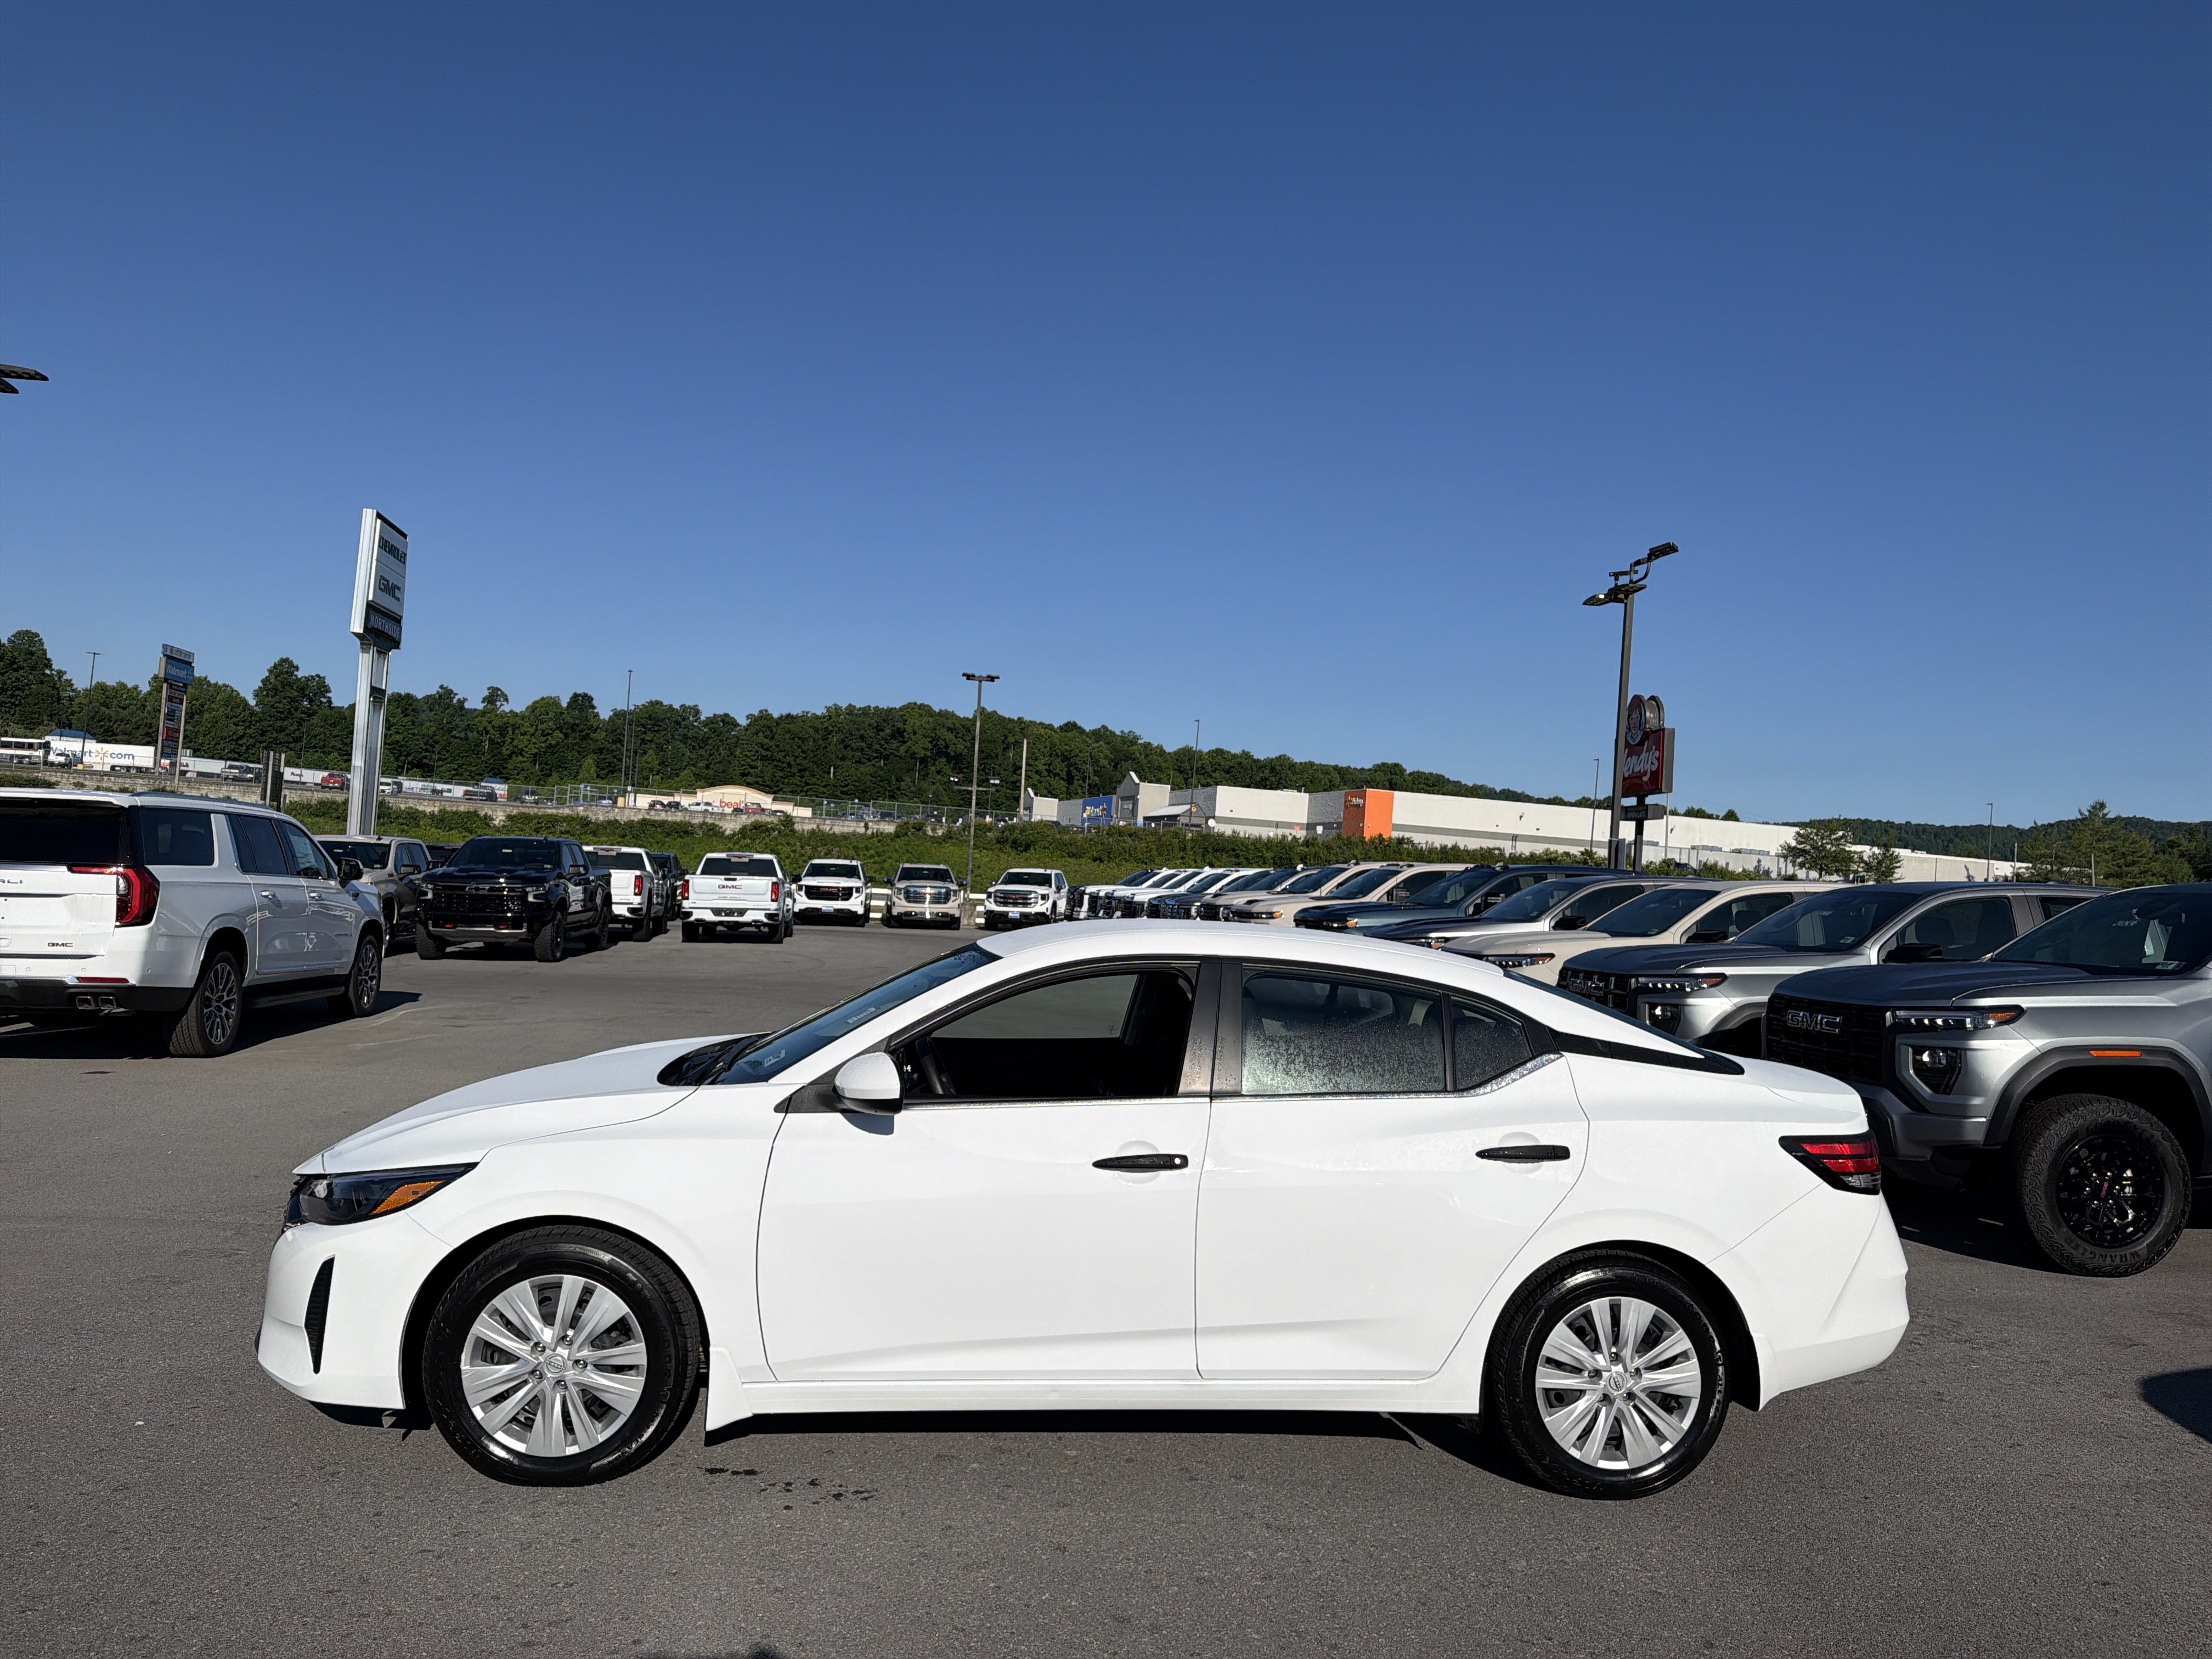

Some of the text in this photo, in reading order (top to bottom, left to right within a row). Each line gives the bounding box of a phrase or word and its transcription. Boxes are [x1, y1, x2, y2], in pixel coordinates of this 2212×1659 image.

[379, 537, 406, 565] CHEVROLET
[379, 575, 401, 602] GMC
[370, 614, 400, 639] NORTHSIDE
[167, 664, 187, 679] Walmart
[110, 752, 135, 760] com
[1623, 741, 1660, 782] endy's
[1570, 978, 1605, 996] GMC
[1787, 1009, 1843, 1034] GMC
